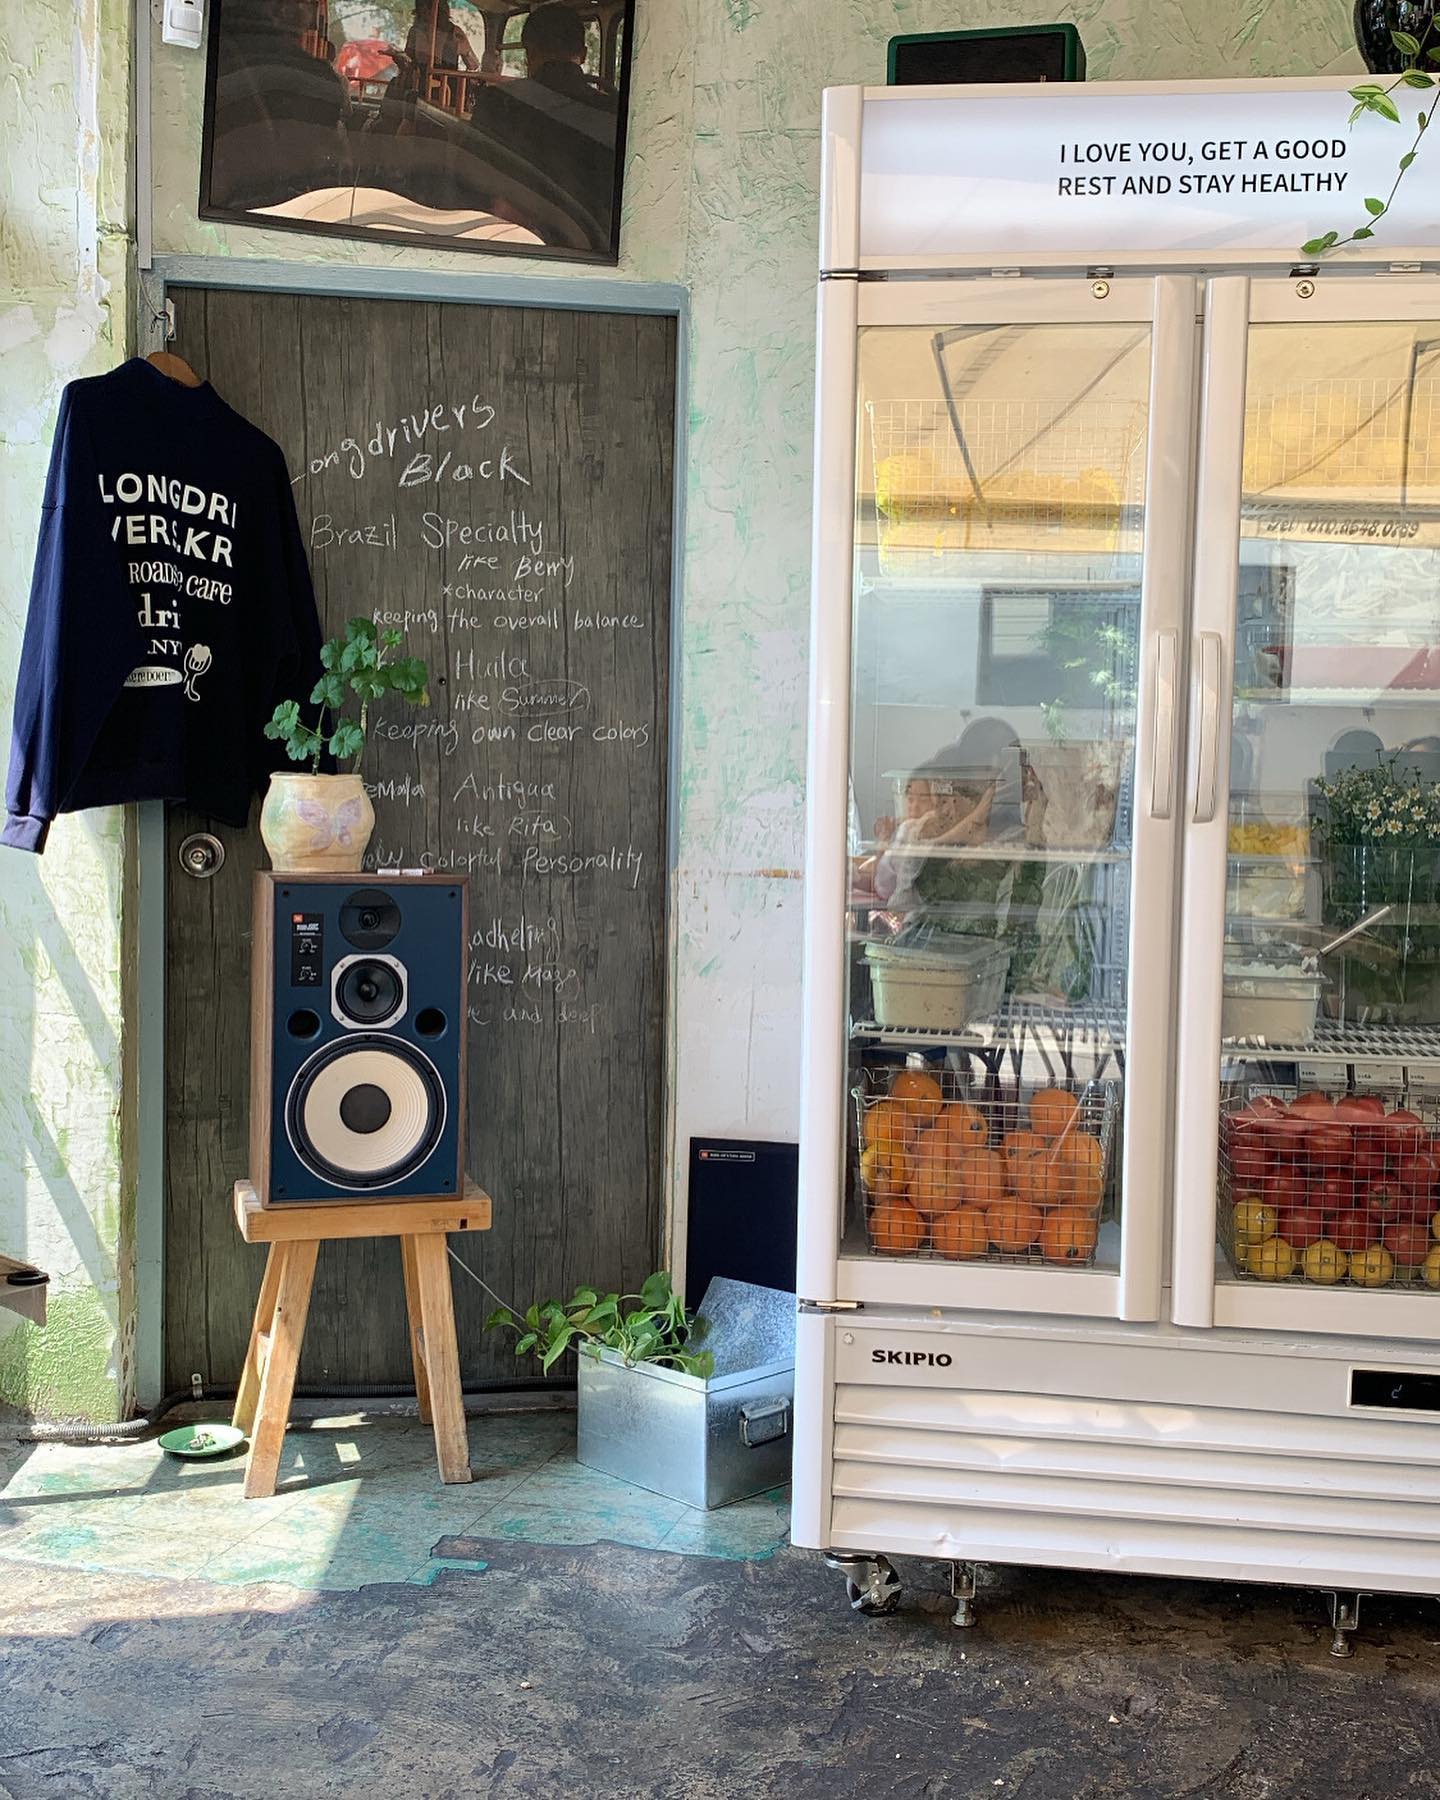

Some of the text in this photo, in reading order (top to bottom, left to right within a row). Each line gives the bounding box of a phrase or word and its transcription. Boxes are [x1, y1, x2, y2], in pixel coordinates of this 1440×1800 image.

[1060, 139, 1347, 166] I LOVE YOU, GET A GOOD
[1058, 172, 1349, 196] REST AND STAY HEALTHY
[290, 394, 496, 485] ongdrivers
[399, 446, 531, 488] Black
[98, 473, 237, 529] LONGDRI
[310, 509, 543, 555] Brazil Specialty
[457, 554, 575, 588] like Berry
[446, 608, 482, 633] the
[493, 609, 559, 630] overall
[574, 609, 645, 630] balance
[455, 689, 491, 711] like
[472, 724, 517, 745] own
[592, 719, 649, 747] colors
[453, 772, 557, 808] Antigua
[456, 817, 495, 837] like
[467, 957, 515, 985] like
[503, 1002, 543, 1024] and
[871, 1349, 953, 1367] SKIPIO
